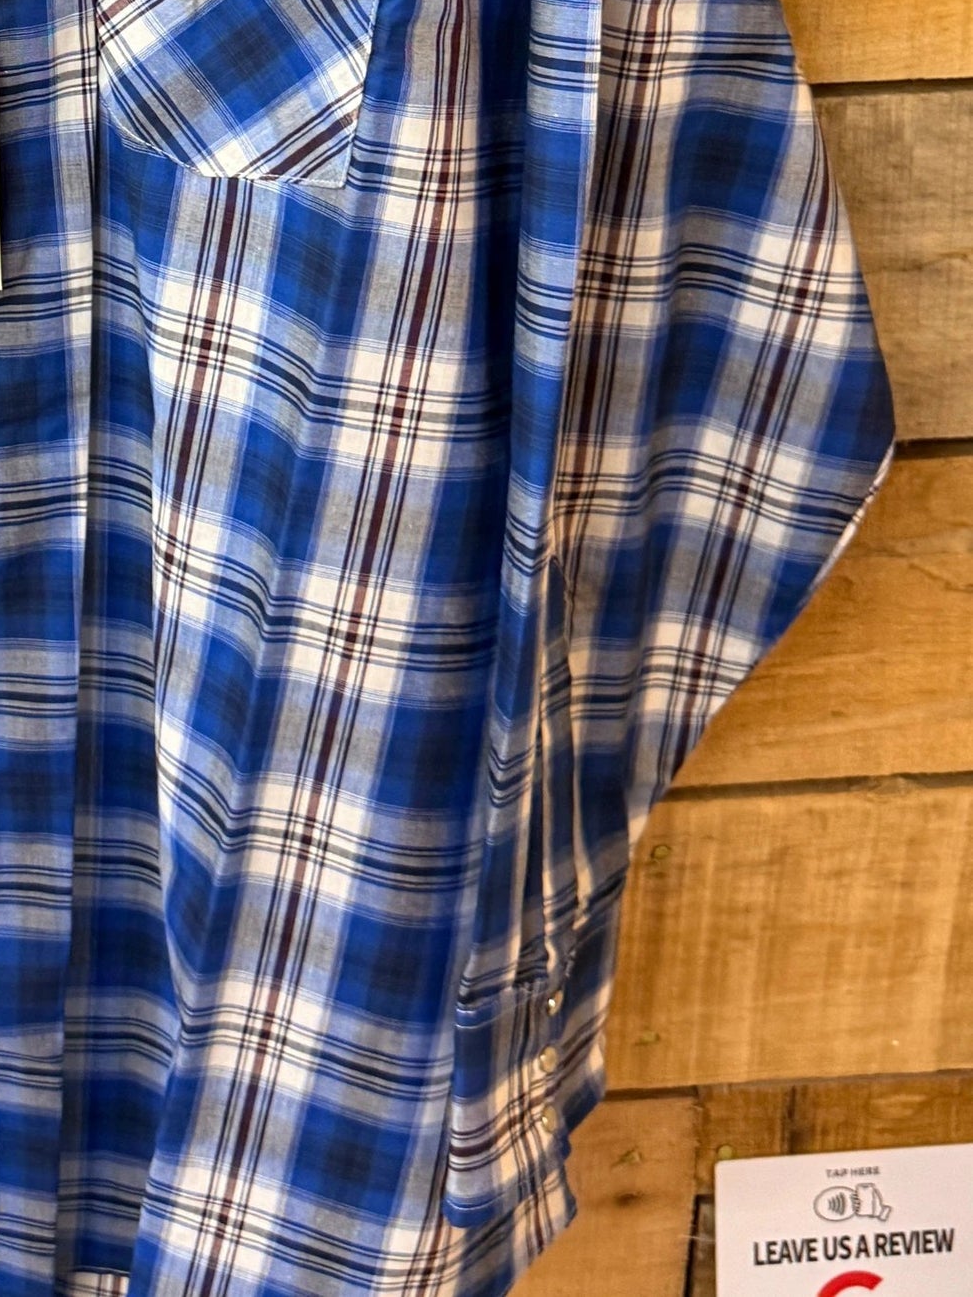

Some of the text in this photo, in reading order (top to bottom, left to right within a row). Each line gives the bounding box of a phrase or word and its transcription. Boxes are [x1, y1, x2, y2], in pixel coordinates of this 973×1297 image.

[826, 1166, 881, 1179] TAP HERE
[753, 1228, 955, 1266] LEAVE US A REVIEW
